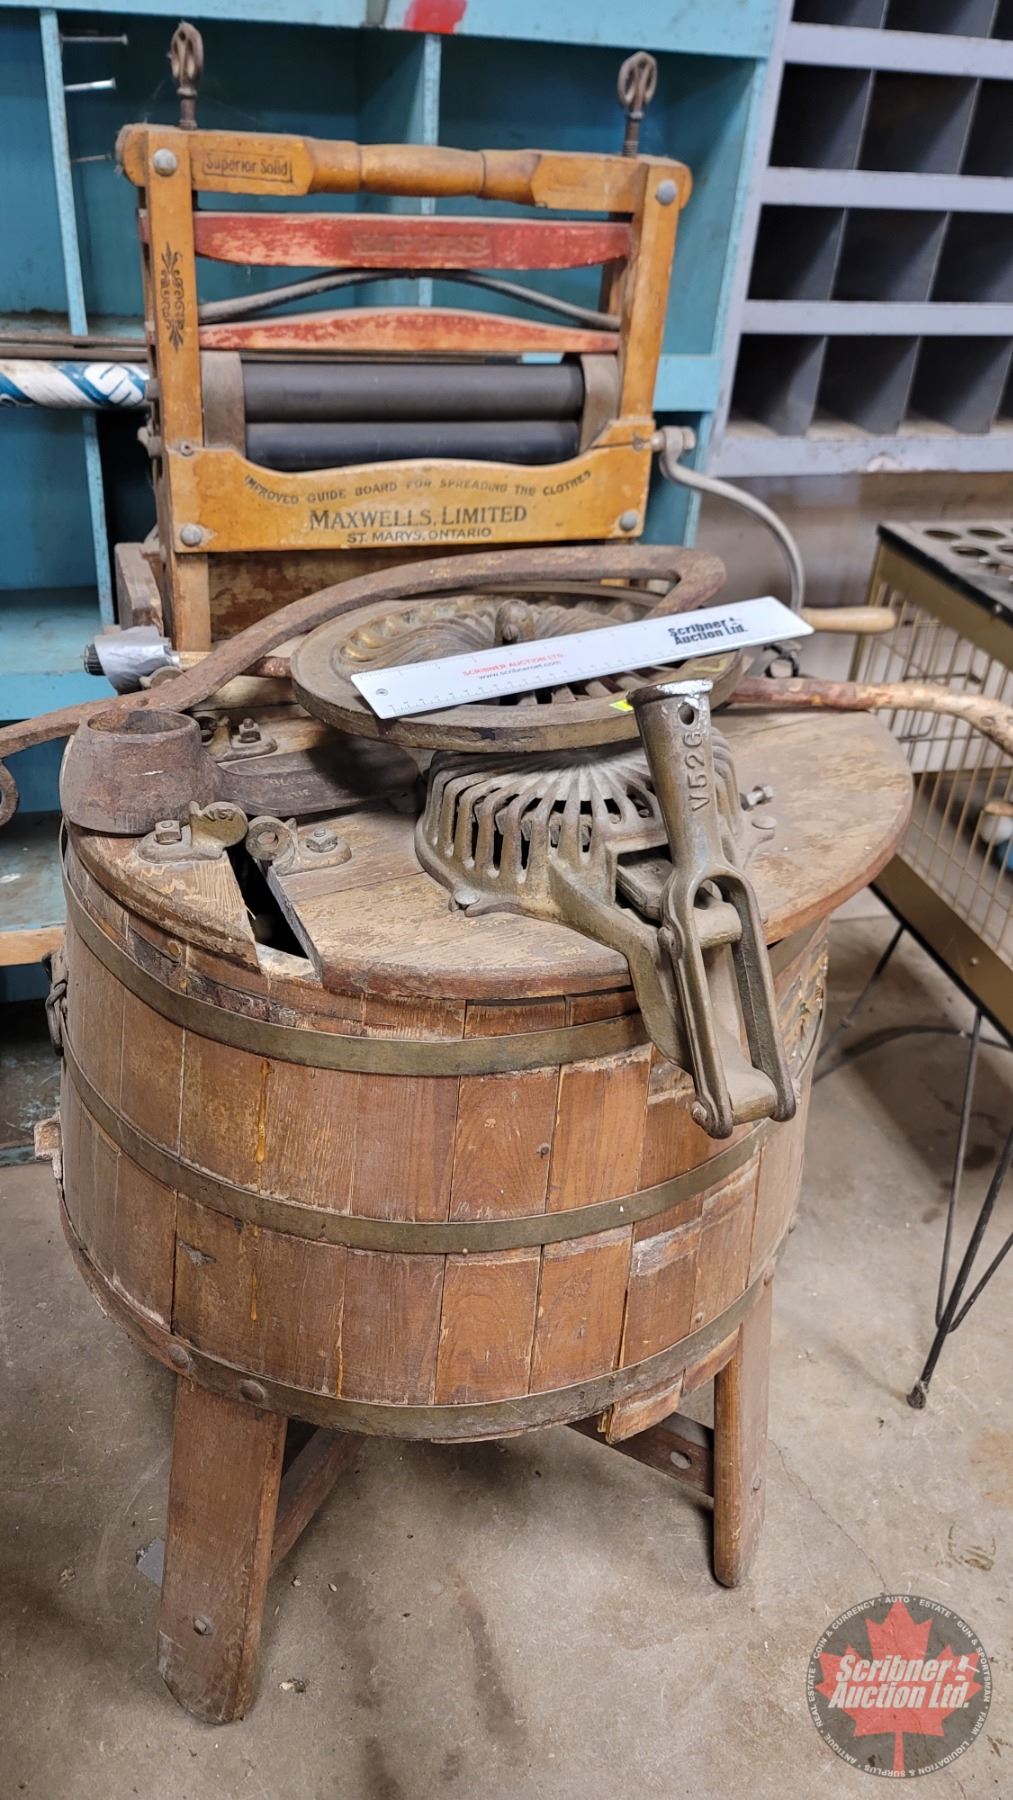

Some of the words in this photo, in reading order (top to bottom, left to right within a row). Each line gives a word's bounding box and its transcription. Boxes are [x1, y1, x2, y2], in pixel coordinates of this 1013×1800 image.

[206, 154, 256, 175] Superior
[260, 158, 288, 176] Solid
[244, 474, 299, 504] IMPROVED
[307, 489, 346, 503] GUIDE
[355, 481, 398, 497] BOARD
[406, 479, 431, 489] FOR
[440, 478, 509, 493] SPREADING
[515, 484, 536, 496] THE
[543, 470, 592, 497] CLOTHES
[441, 505, 528, 526] LIMITED
[428, 527, 492, 541] ONTARIO
[674, 629, 724, 645] Auction
